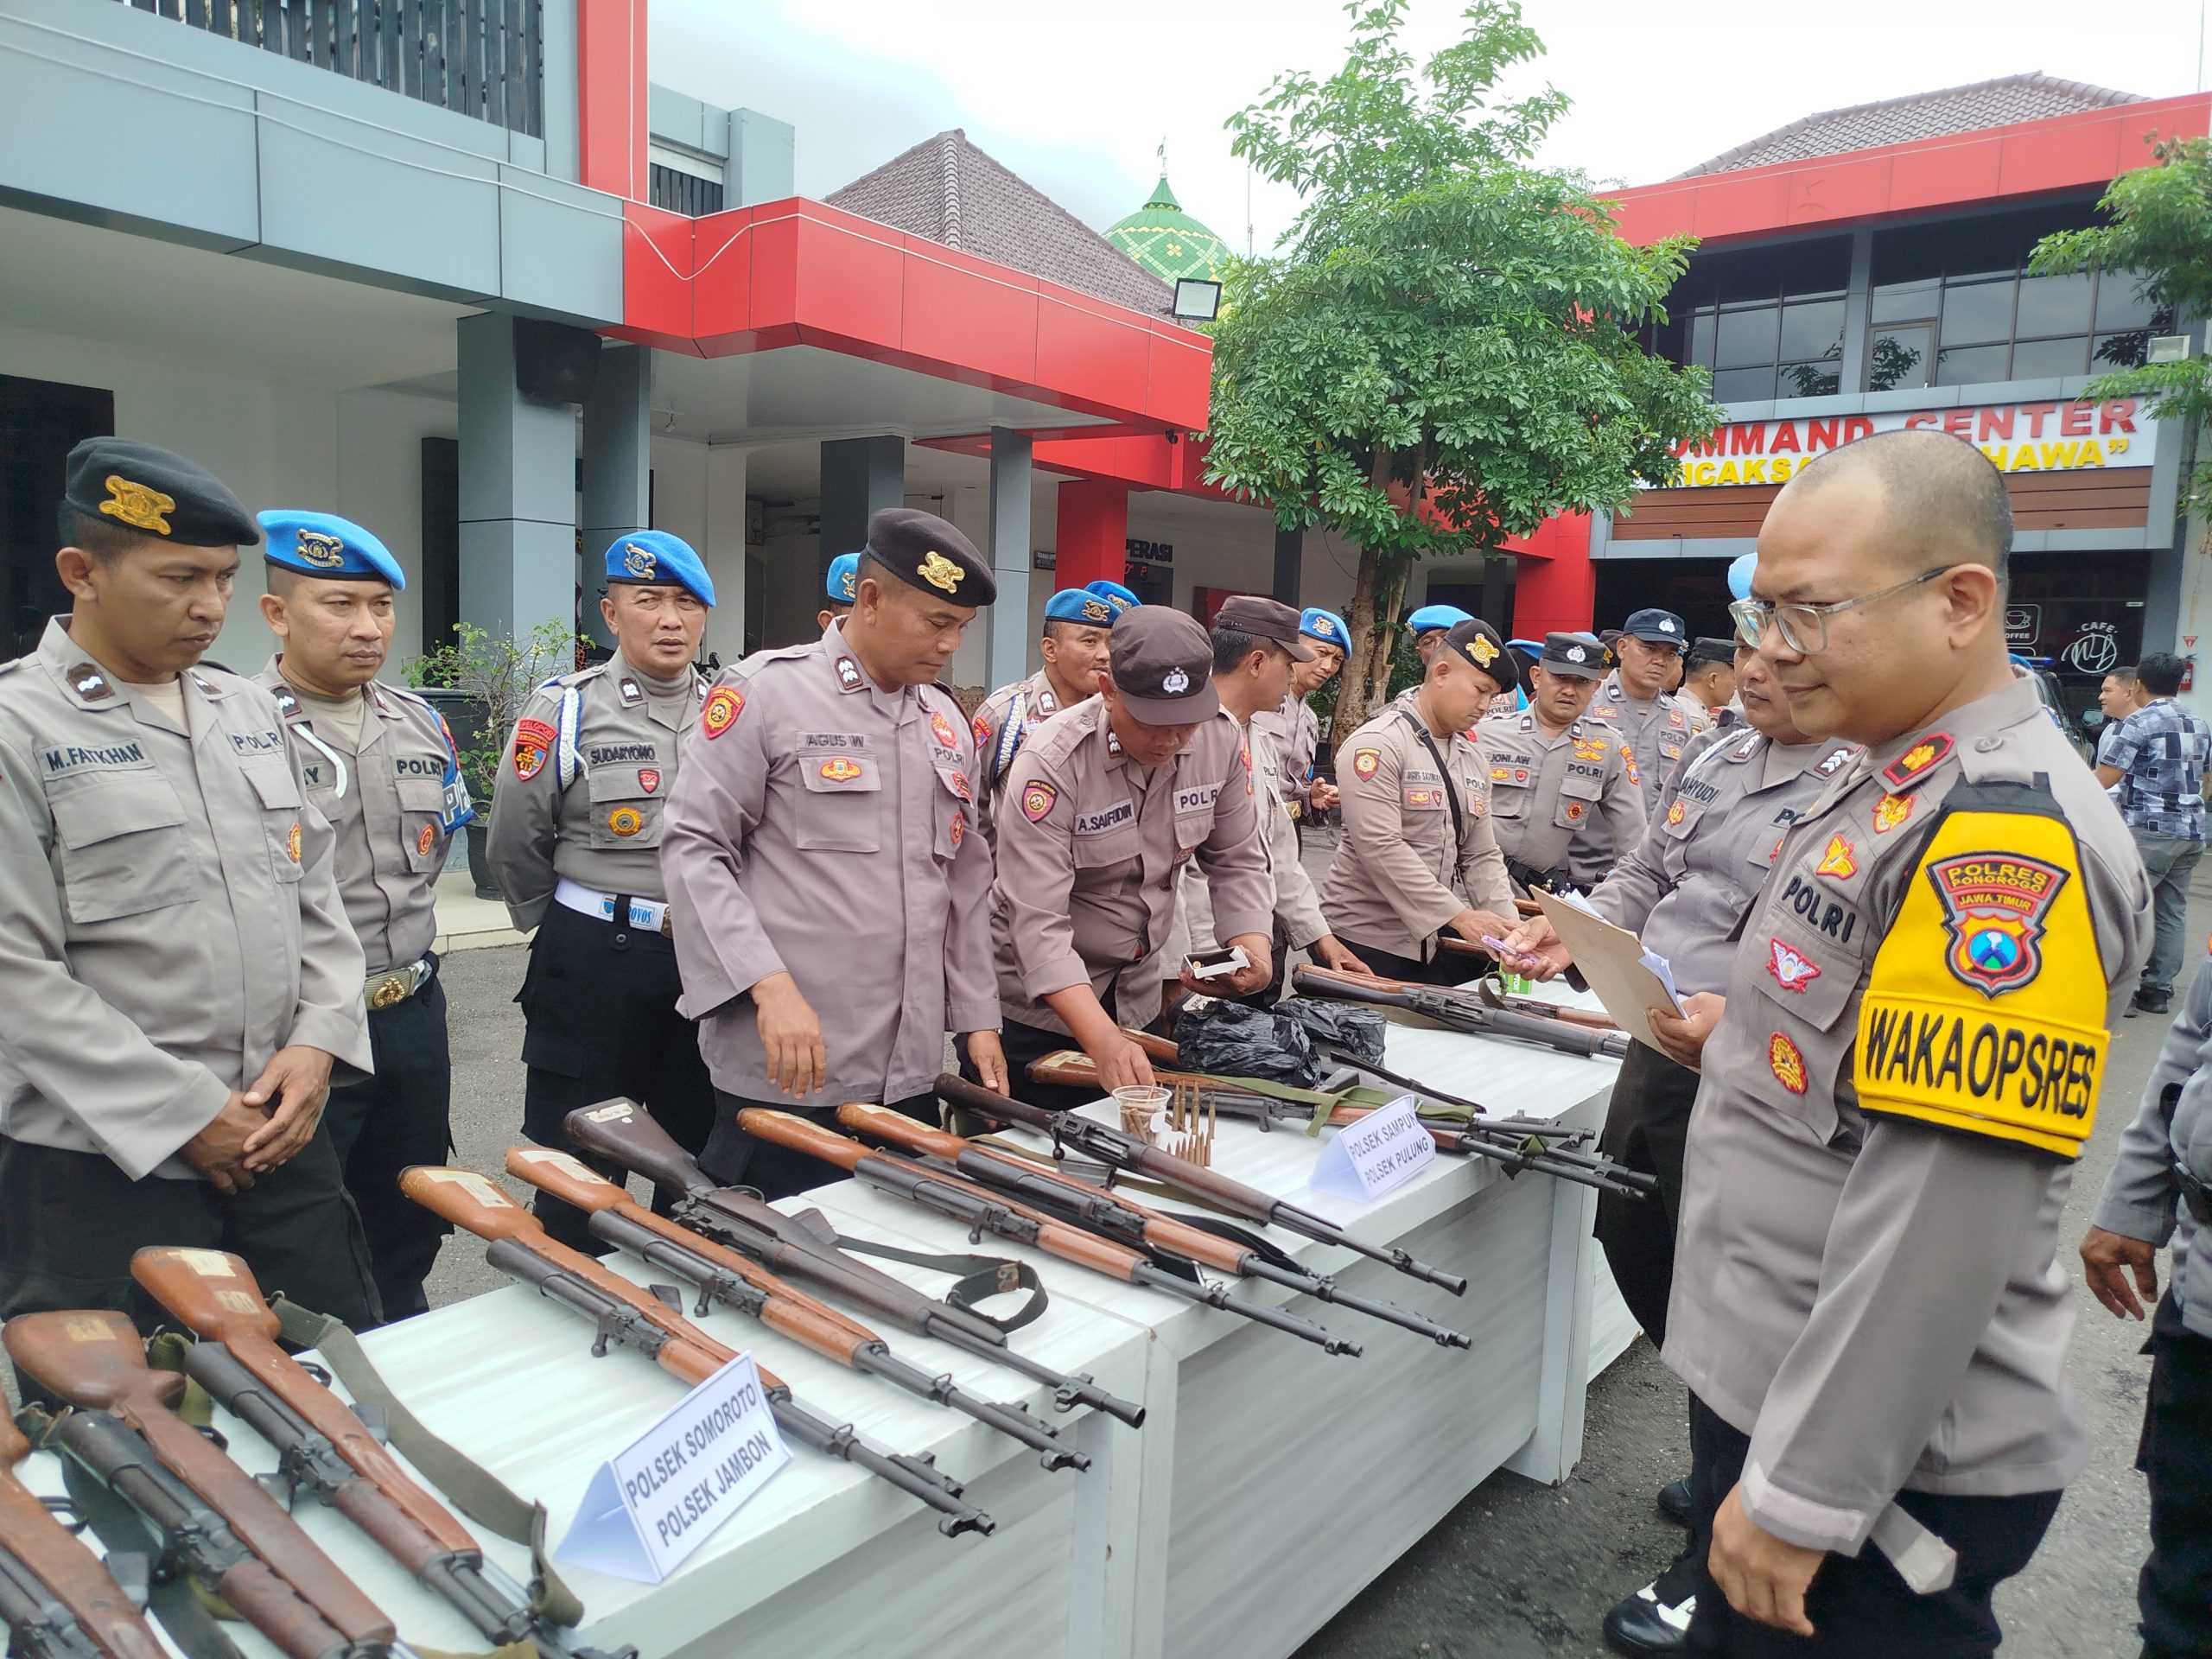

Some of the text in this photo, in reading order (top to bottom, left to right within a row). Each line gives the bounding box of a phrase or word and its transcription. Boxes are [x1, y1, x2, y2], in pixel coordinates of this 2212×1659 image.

[1981, 438, 2130, 471] HAWA”
[2081, 621, 2116, 633] CAFE
[233, 732, 283, 751] POLR
[807, 734, 847, 747] AGUS
[1660, 730, 1685, 747] POLRI
[1567, 763, 1603, 779] POLRI
[1179, 788, 1219, 809] POLR
[1681, 776, 1719, 803] AHYUDI
[1948, 862, 2049, 887] POLRES
[1951, 875, 2043, 893] PONOROGO
[1781, 874, 1857, 944] POLRI
[1958, 893, 2032, 912] JAWA TIMUR
[1866, 1007, 2095, 1120] WAKAOPSRES
[1349, 1129, 1383, 1160] POLSEK
[1364, 1136, 1429, 1188] POLSEK PULUNG
[626, 1383, 757, 1508] POLSEK SOMOROTO
[657, 1429, 773, 1548] POLSEK JAMBON
